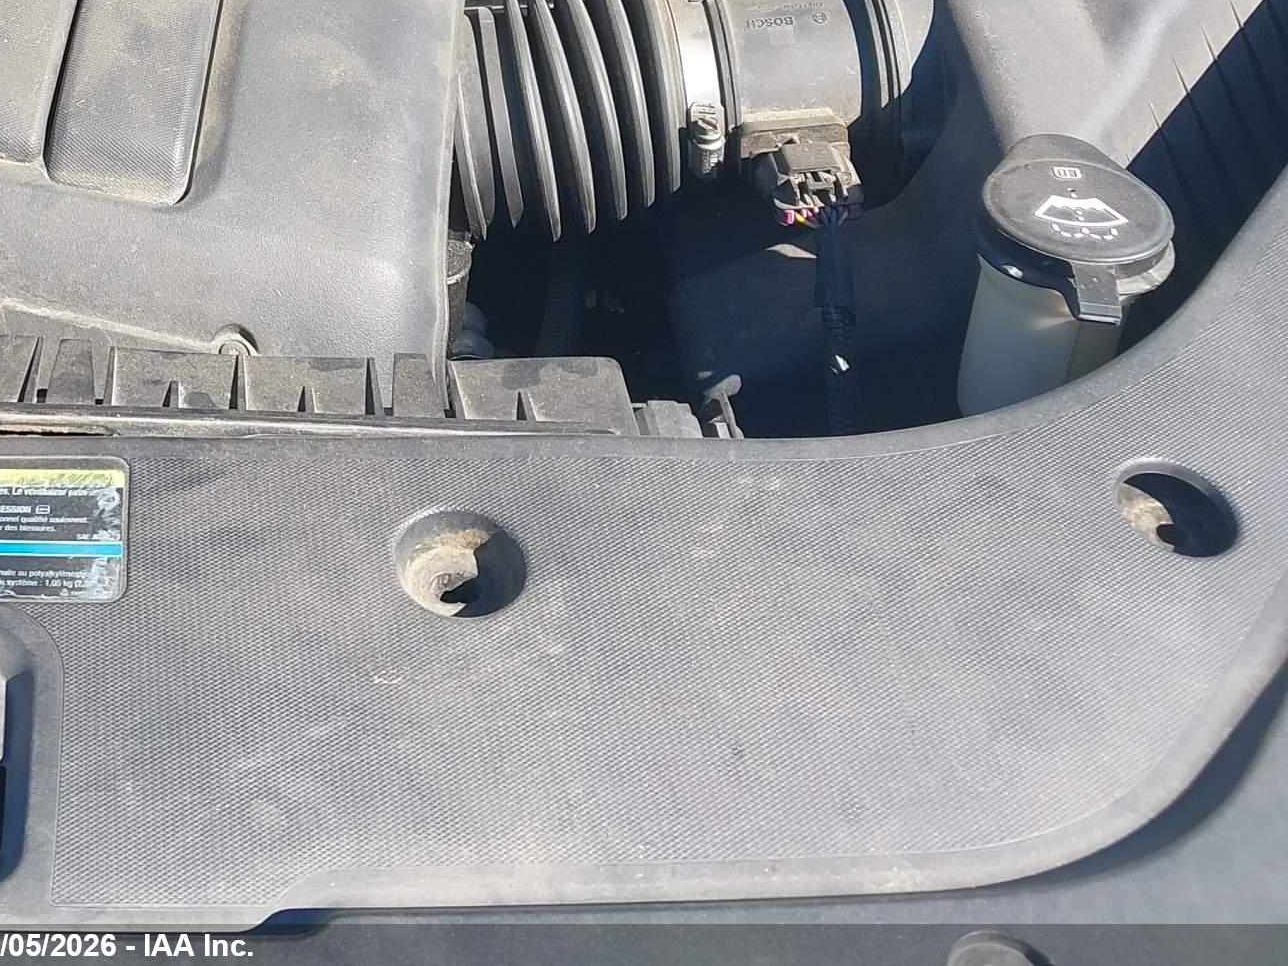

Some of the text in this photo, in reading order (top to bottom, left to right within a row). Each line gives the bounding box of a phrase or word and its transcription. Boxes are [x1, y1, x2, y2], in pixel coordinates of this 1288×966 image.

[745, 15, 794, 29] BOSCH
[12, 487, 23, 495] Le
[19, 524, 57, 532] blessures.
[63, 579, 75, 589] kg
